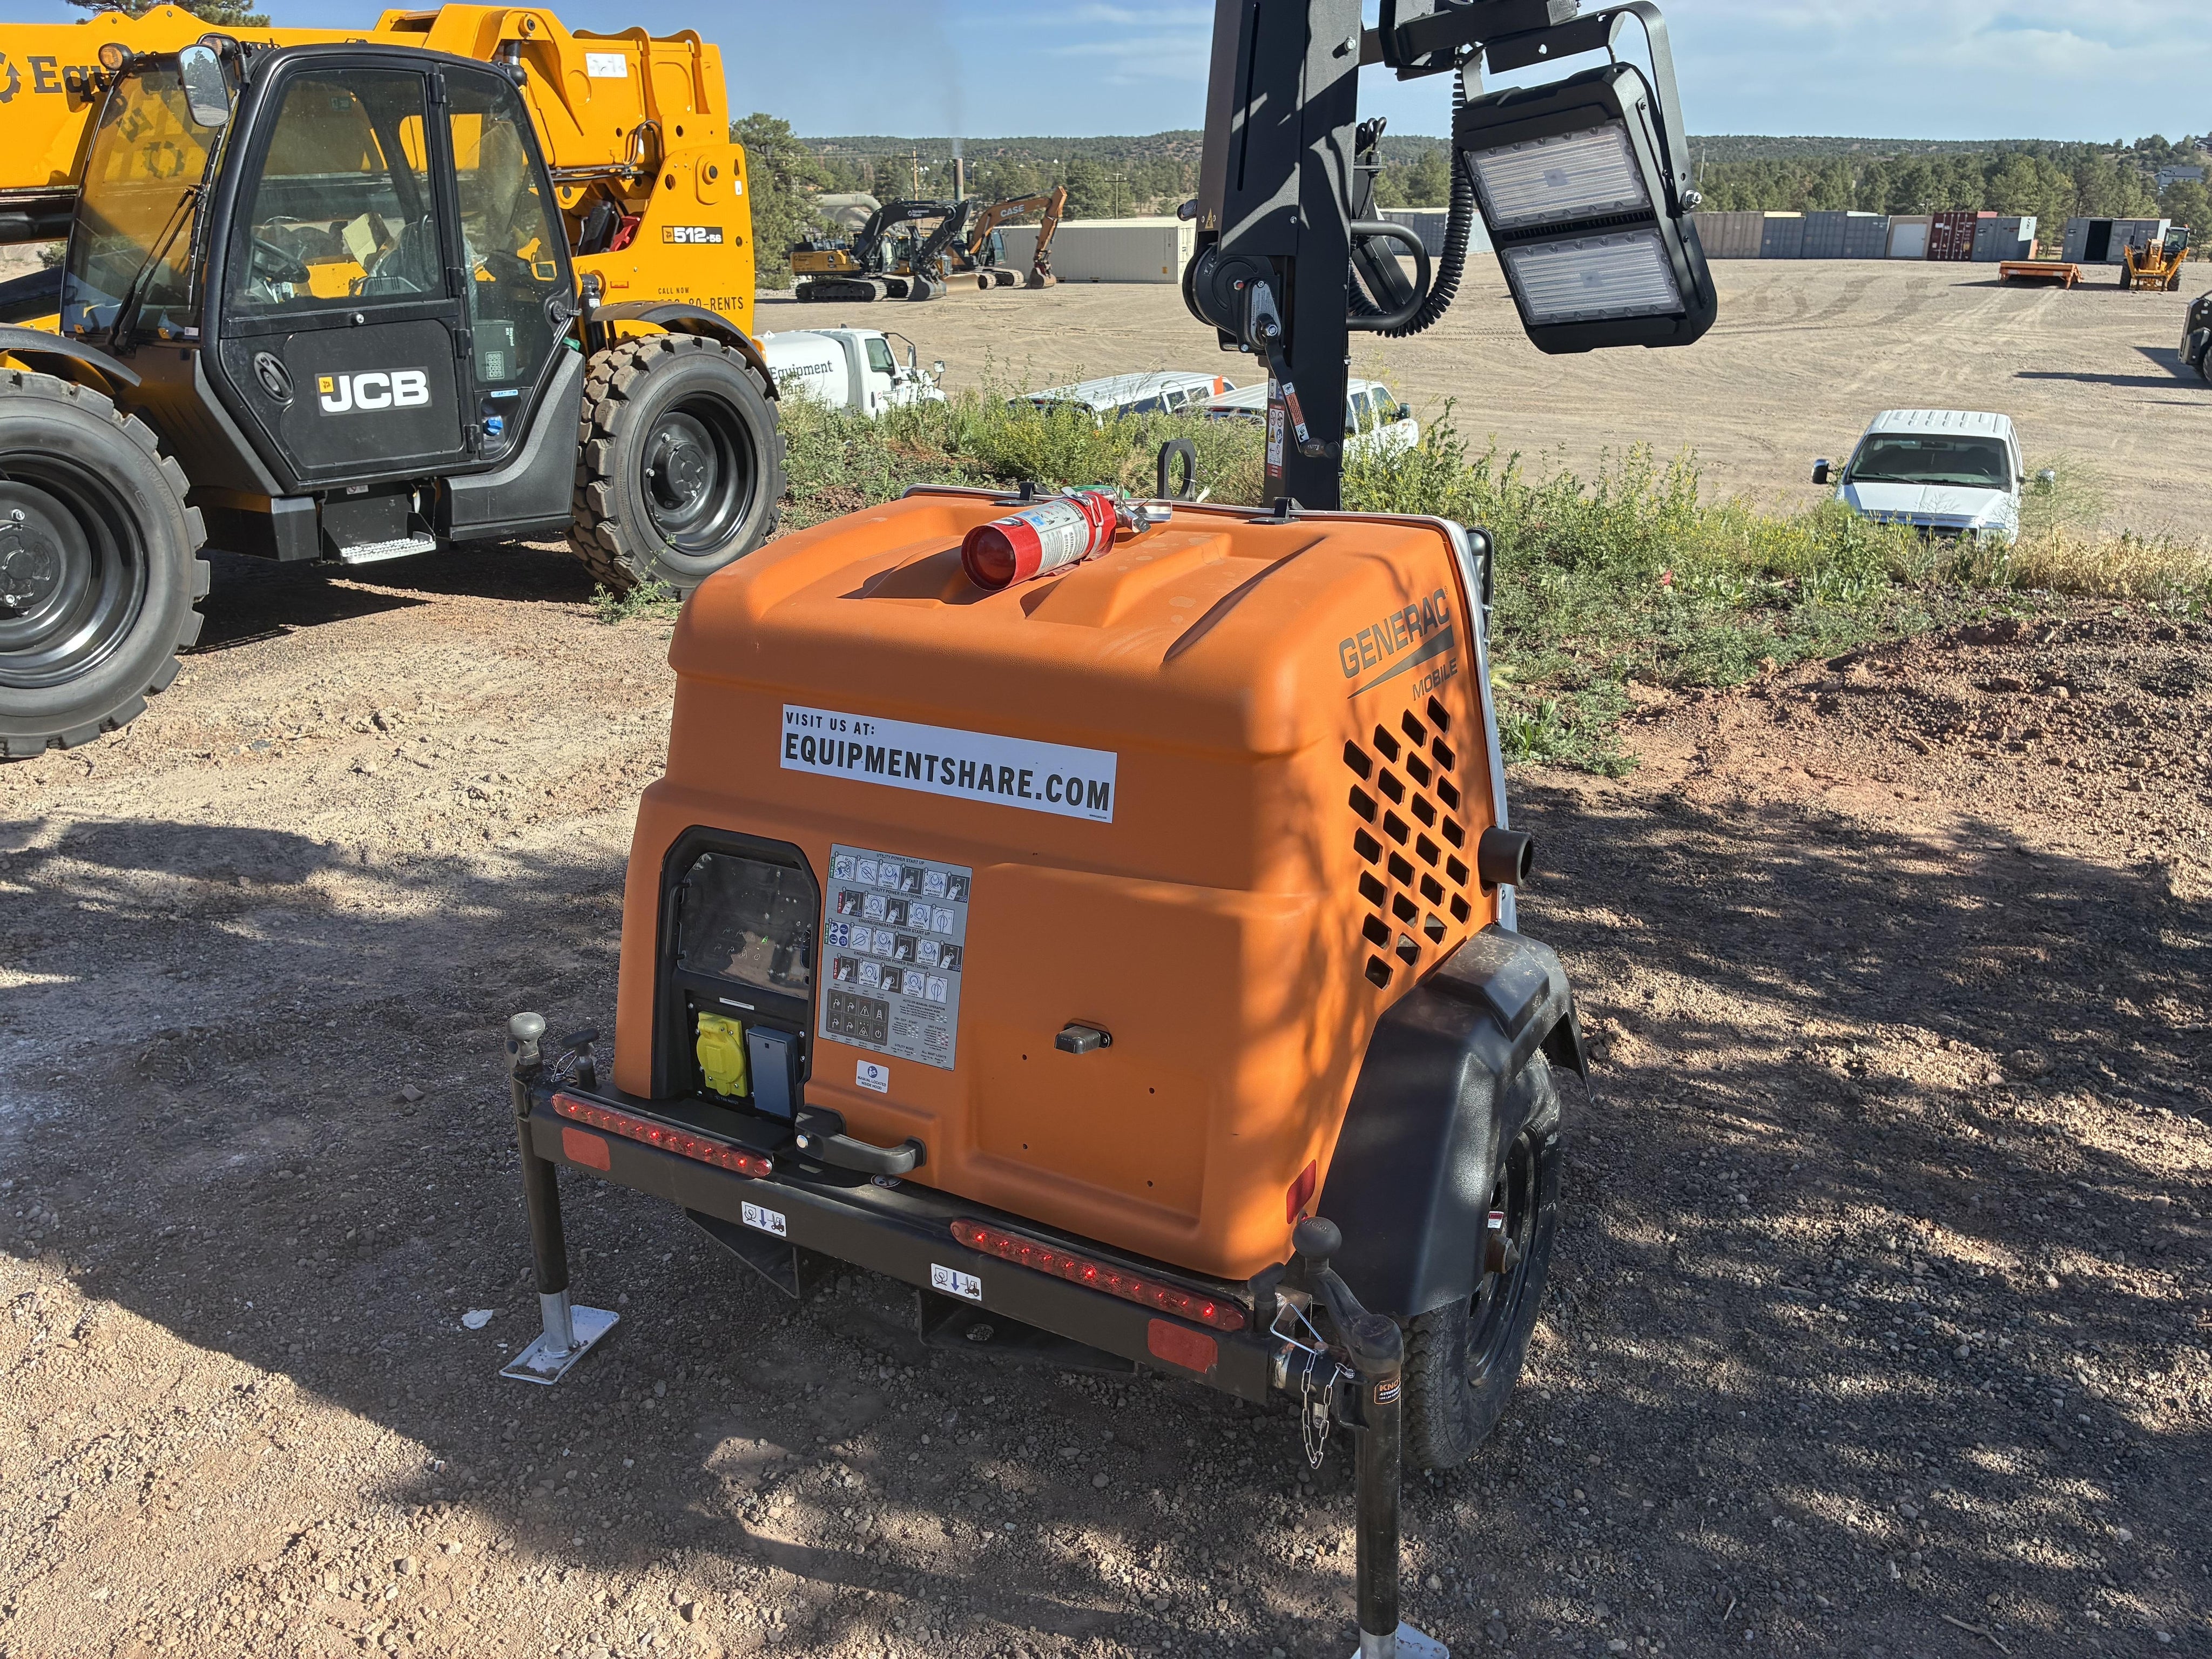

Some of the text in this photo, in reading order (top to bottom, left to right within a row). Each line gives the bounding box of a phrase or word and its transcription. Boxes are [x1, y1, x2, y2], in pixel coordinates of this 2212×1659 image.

[1000, 205, 1024, 217] CASE
[768, 360, 833, 381] Equipment
[320, 370, 430, 413] JCB
[1339, 588, 1450, 679] GENERAC
[1412, 657, 1458, 701] MOBILE
[786, 711, 875, 735] VISIT US AT:
[785, 732, 1110, 811] EQUIPMENTSHARE.COM
[900, 892, 922, 900] SHUTDOWN
[853, 950, 892, 962] ENGINE/GENERATOR
[906, 962, 928, 970] SHUTDOWN
